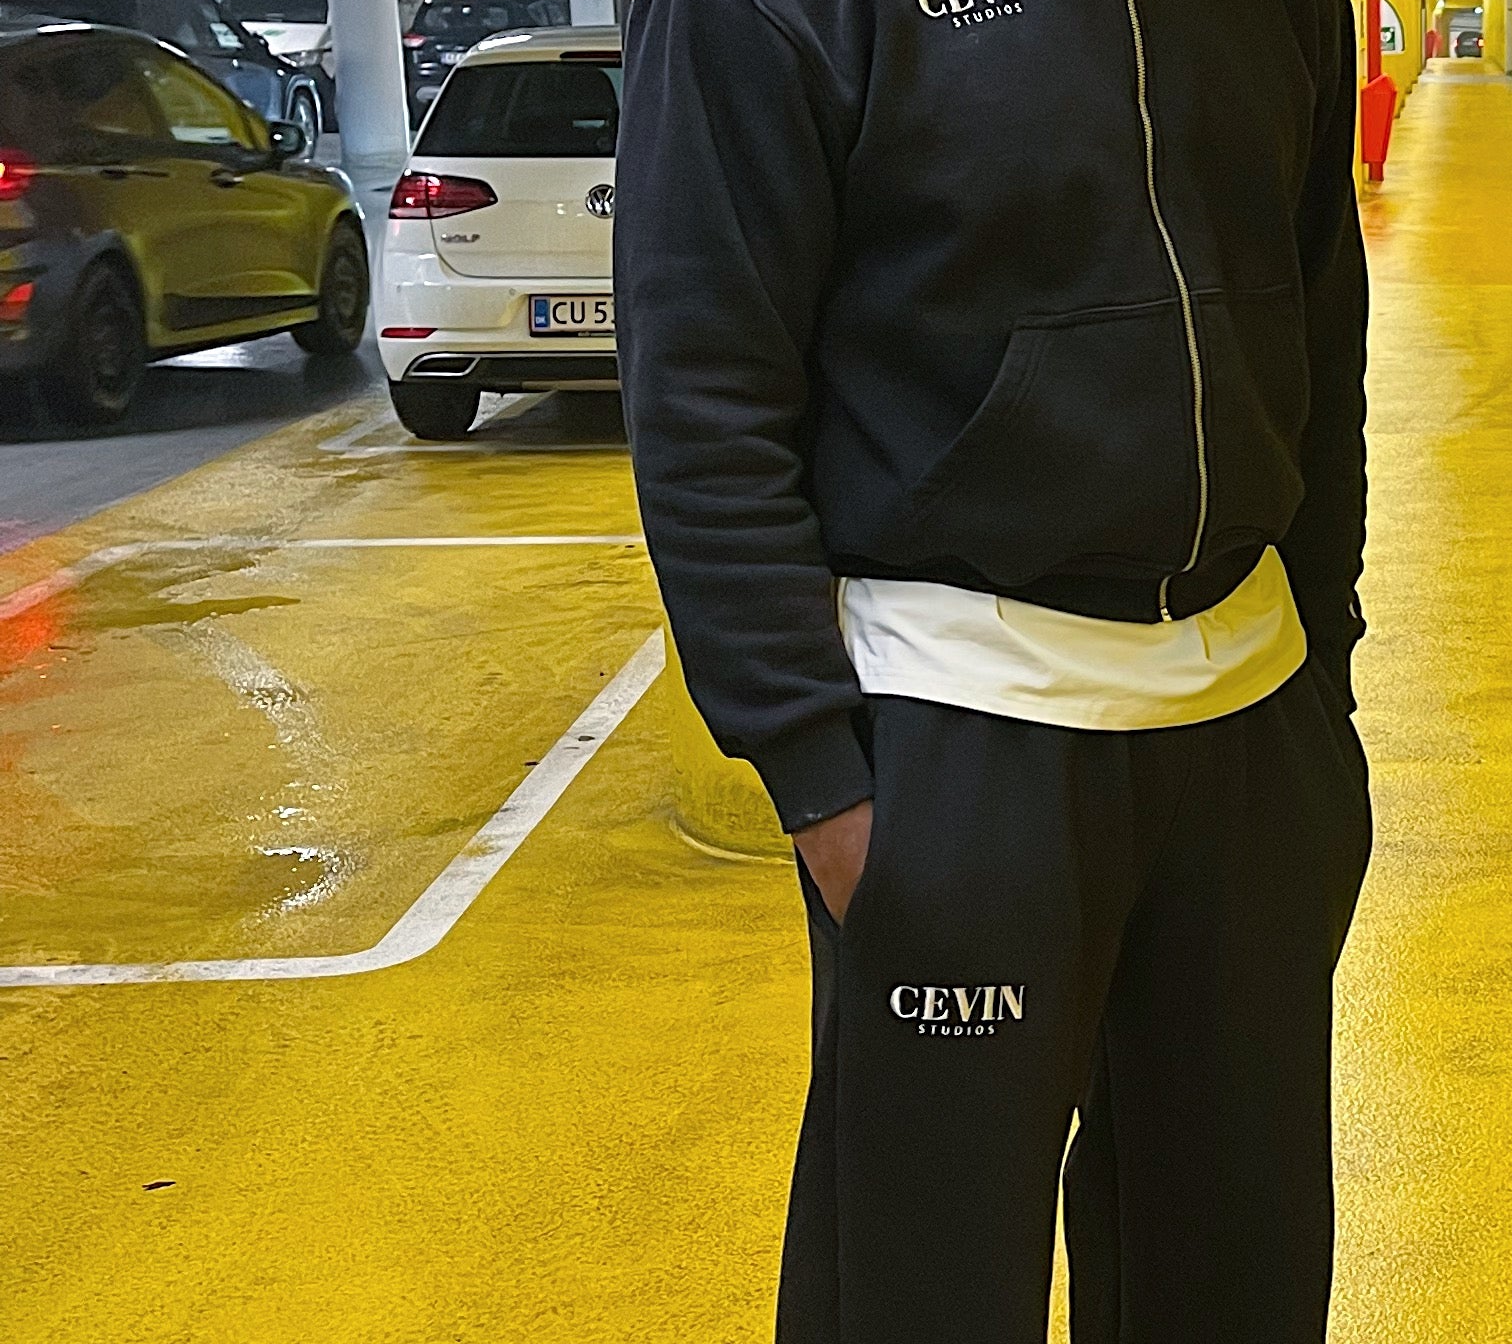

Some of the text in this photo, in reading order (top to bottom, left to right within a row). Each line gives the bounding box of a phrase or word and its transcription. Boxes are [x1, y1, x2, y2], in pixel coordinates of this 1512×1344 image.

[952, 2, 1023, 28] STUDIOS
[552, 301, 616, 325] CU 5
[889, 985, 1026, 1023] CEVIN
[918, 1023, 995, 1036] STUDIOS
